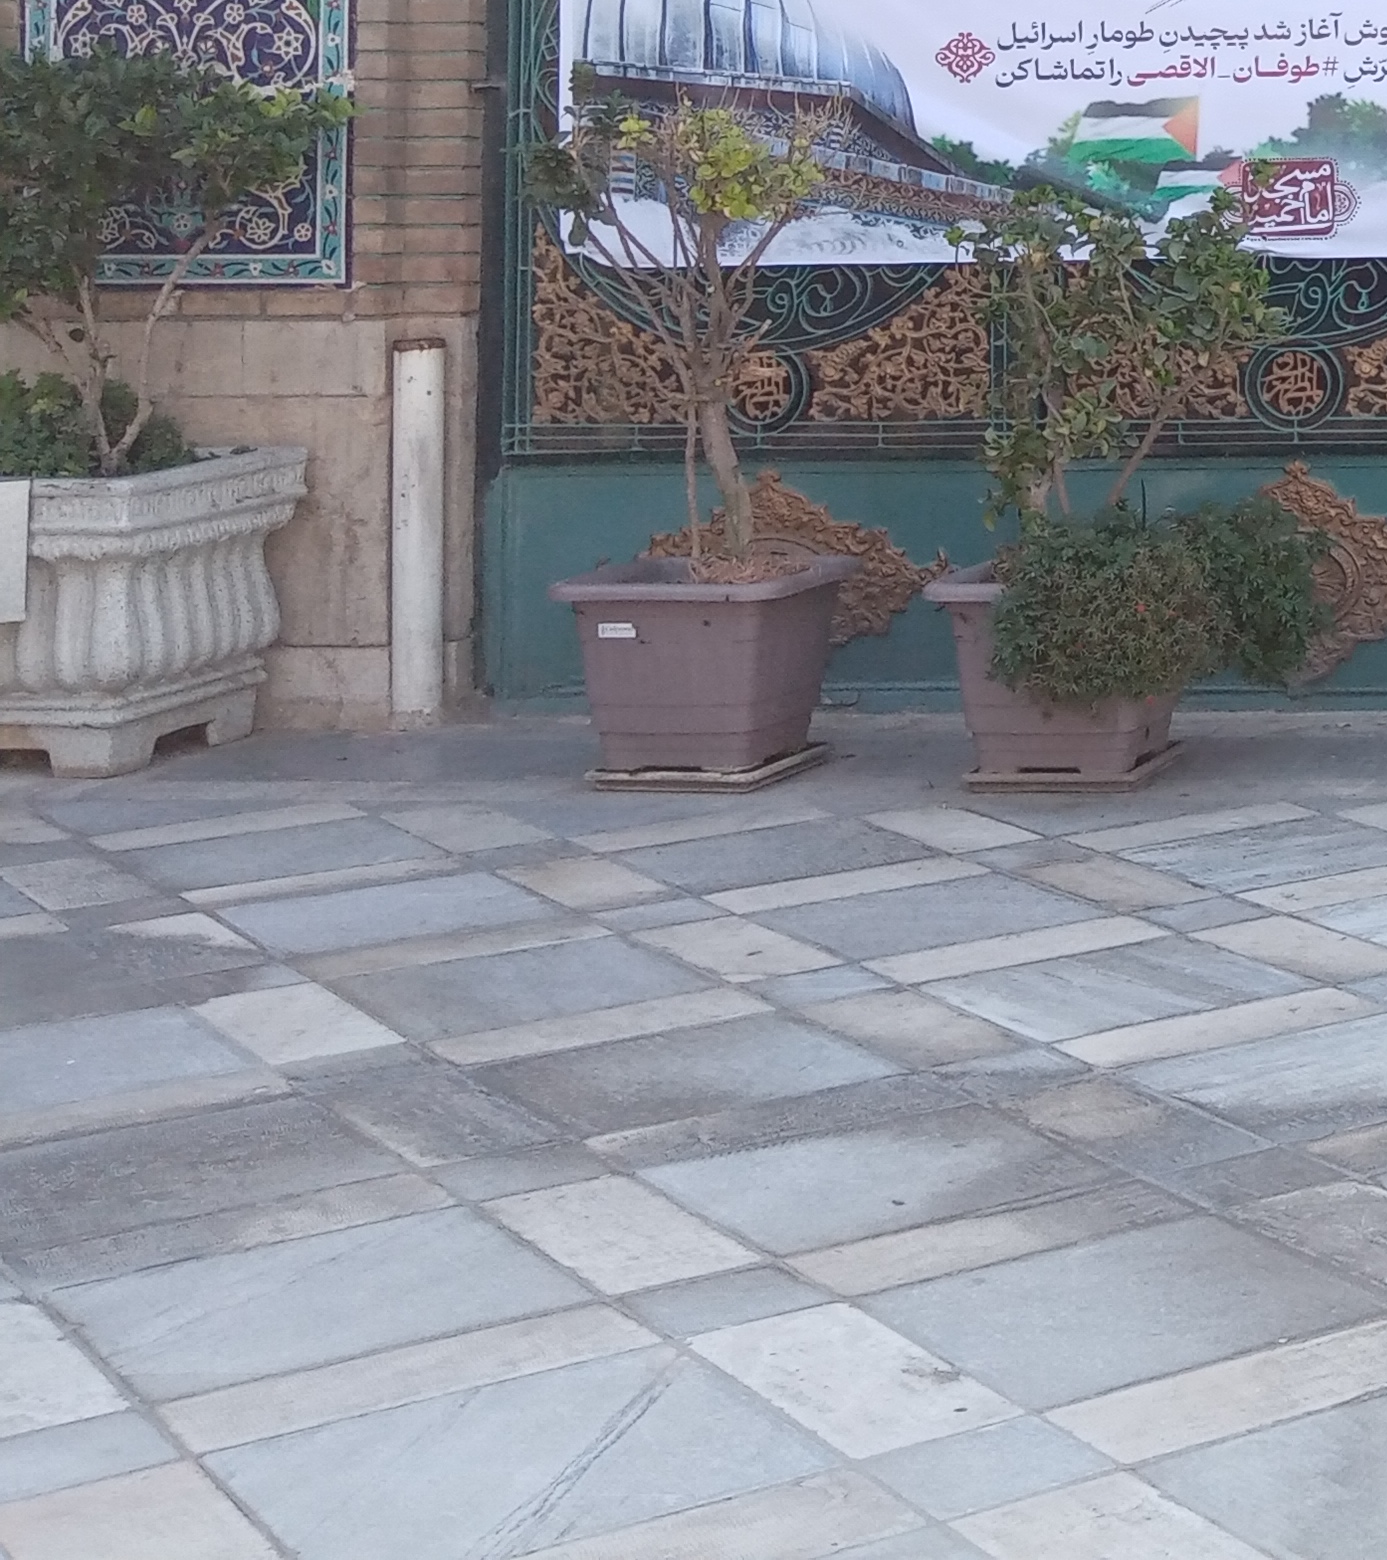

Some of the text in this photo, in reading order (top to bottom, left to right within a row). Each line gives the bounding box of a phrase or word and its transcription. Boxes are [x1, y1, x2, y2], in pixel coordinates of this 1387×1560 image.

[997, 20, 1083, 50] اسرائیل
[1254, 21, 1292, 40] شد
[1294, 12, 1343, 46] آغاز
[1109, 58, 1122, 86] را
